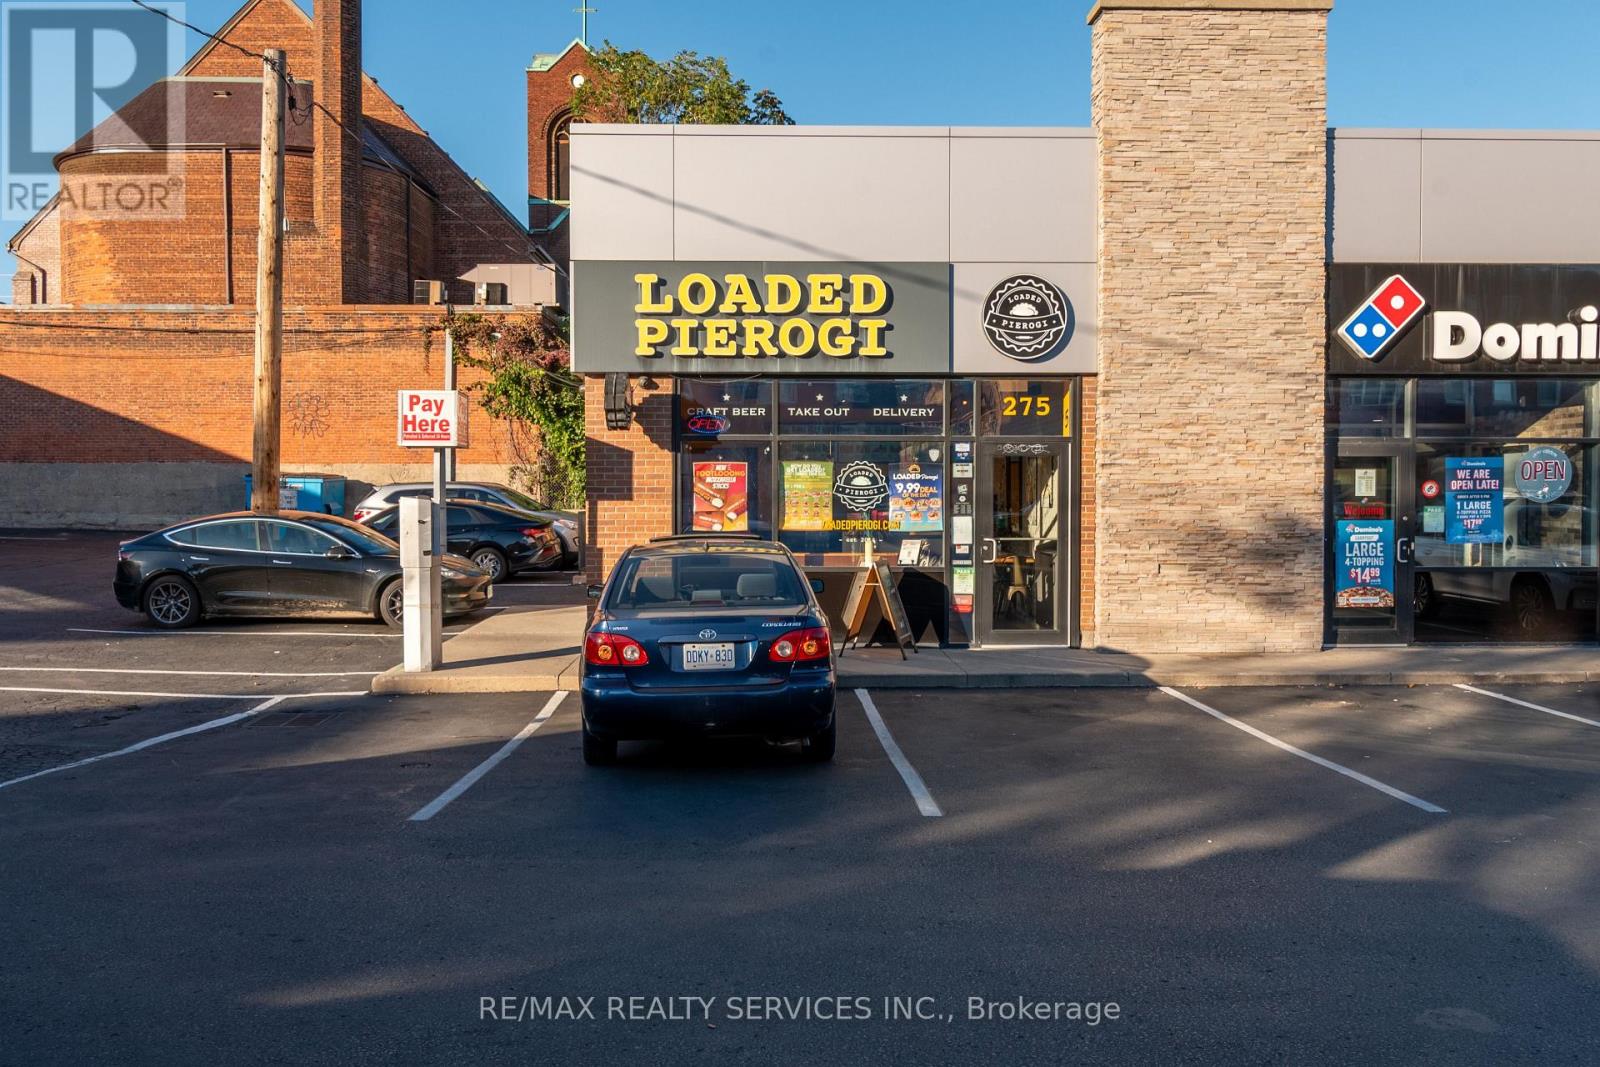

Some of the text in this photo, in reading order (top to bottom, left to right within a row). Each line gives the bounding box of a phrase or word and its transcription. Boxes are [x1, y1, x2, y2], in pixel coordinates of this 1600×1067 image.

[634, 273, 887, 315] LOADED
[1008, 293, 1042, 303] LOADED
[1002, 319, 1048, 330] PIEROGI
[634, 318, 887, 357] PIEROGI
[1433, 305, 1600, 361] Domi
[408, 394, 445, 416] Pay
[1003, 396, 1051, 416] 275
[687, 407, 766, 417] CRAFT BEER
[788, 407, 850, 417] TAKE OUT
[873, 407, 935, 417] DELIVERY
[403, 414, 451, 432] Here
[687, 417, 727, 431] OPEN
[849, 470, 874, 478] LOADED
[1457, 469, 1490, 479] WE ARE
[1521, 460, 1566, 481] OPEN
[920, 486, 938, 494] DEAL
[1451, 480, 1499, 490] OPEN LATE!
[845, 488, 878, 496] PIEROGI
[1456, 501, 1492, 510] 1 LARGE
[1345, 542, 1384, 557] LARGE
[1345, 557, 1384, 566] 4-TOPPING
